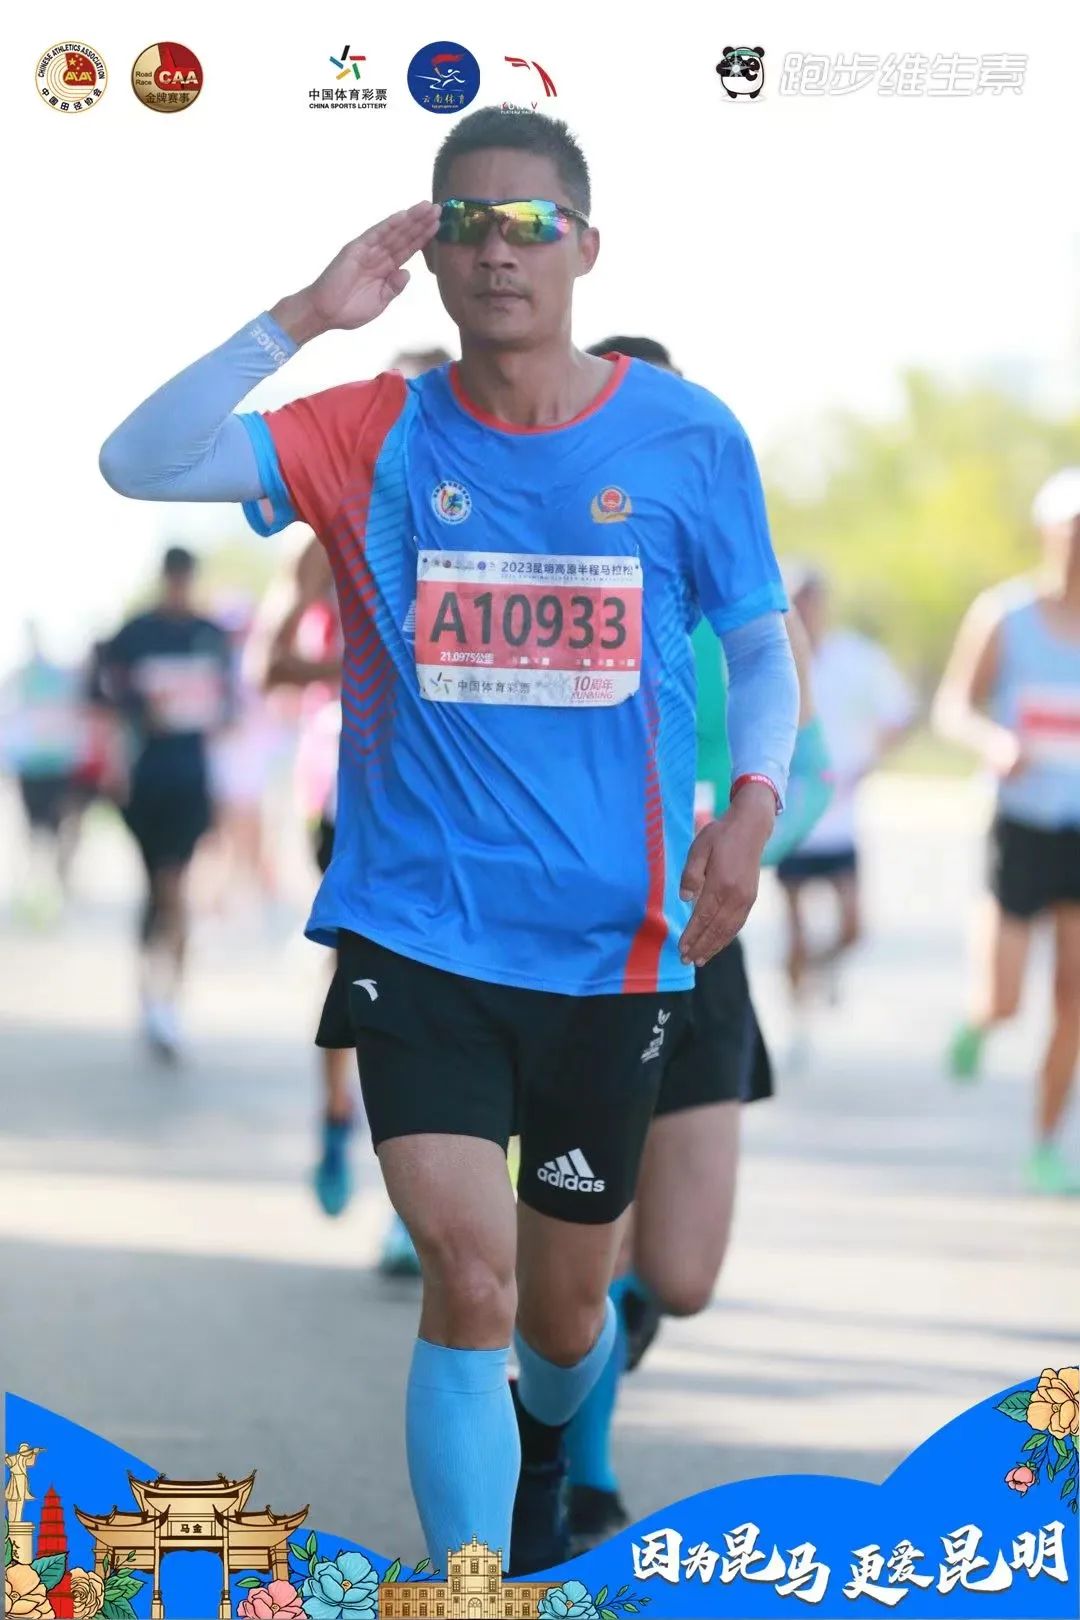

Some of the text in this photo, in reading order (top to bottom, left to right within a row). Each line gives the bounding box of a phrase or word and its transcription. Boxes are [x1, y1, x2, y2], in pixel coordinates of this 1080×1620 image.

[429, 591, 627, 650] A10933
[457, 680, 531, 695] 中国体育彩票
[537, 1167, 605, 1192] adidas
